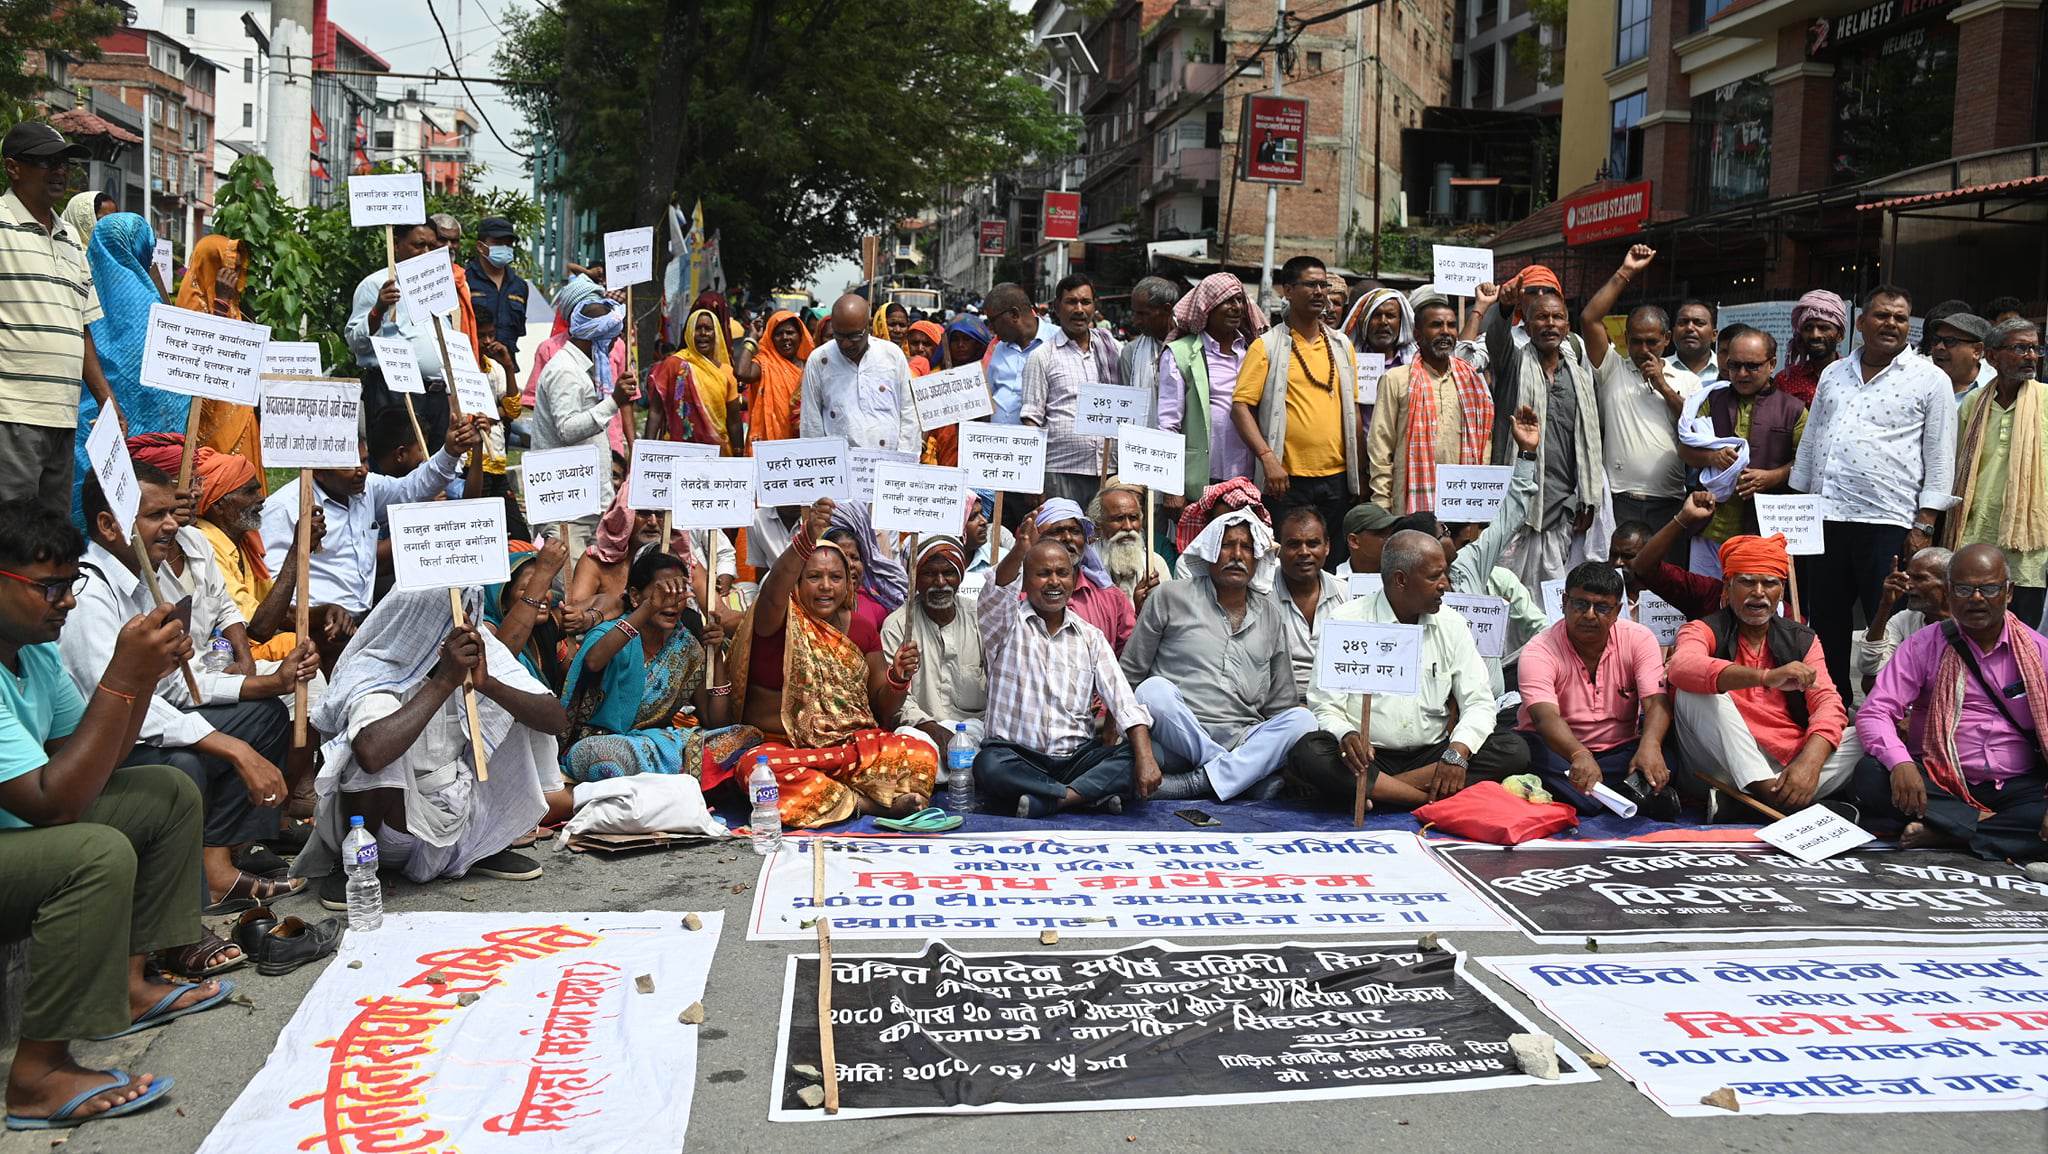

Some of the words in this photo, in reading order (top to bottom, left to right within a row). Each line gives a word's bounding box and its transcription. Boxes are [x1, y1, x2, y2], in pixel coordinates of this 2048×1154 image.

[1837, 1, 1894, 39] HELMETS
[1576, 200, 1608, 225] CHICKEN
[1609, 192, 1643, 219] STATION
[184, 326, 216, 340] प्रशासन
[216, 335, 261, 349] कार्यालयमा
[167, 367, 201, 381] अधिकार
[1093, 397, 1112, 409] २४९
[1086, 413, 1113, 424] खारेज
[967, 433, 1008, 446] अदालतमा
[1012, 436, 1039, 447] कपाली
[766, 457, 791, 472] प्रहरी
[796, 456, 837, 469] प्रशासन
[972, 451, 1014, 463] तमसुकको
[528, 472, 553, 487] २०८०
[556, 465, 595, 481] अध्यादेश
[643, 469, 673, 481] तमसुक
[982, 468, 999, 479] दर्ता
[1002, 470, 1015, 481] गर
[763, 479, 788, 492] दवन
[819, 476, 835, 488] गर
[884, 479, 907, 490] कानुन
[938, 483, 958, 494] गरेको
[1446, 479, 1468, 490] प्रहरी
[1470, 481, 1504, 491] प्रशासन
[538, 490, 564, 505] खारेज
[567, 488, 581, 500] गर
[691, 499, 713, 510] सहज
[717, 499, 730, 510] गर
[882, 492, 904, 503] लगानी
[906, 494, 929, 505] कानुन
[1487, 499, 1501, 508] गर
[402, 525, 431, 537] कानुन
[434, 519, 467, 533] बमोजिम
[470, 517, 495, 529] गरेको
[403, 540, 431, 552] लगानी
[435, 538, 461, 551] कानुन
[419, 556, 442, 568] फिर्ता
[445, 553, 479, 566] गरियोस्
[1472, 604, 1502, 615] कपाली
[1646, 600, 1669, 609] अदाल
[1342, 639, 1367, 655] २४९
[1334, 661, 1370, 677] खारेज
[1376, 664, 1395, 678] गर
[950, 838, 1109, 856] लेनदेन
[1127, 840, 1237, 856] संघर्ष
[1253, 838, 1399, 856] समिति
[1600, 850, 1750, 874] लेनदेन
[852, 870, 1057, 891] विरोध
[1078, 871, 1376, 891] कार्यक्रम
[791, 894, 916, 909] २०८०
[1113, 891, 1307, 906] अध्यादेश
[1320, 891, 1452, 907] कानुन
[1589, 882, 1795, 907] विरोध
[1794, 886, 2007, 912] जुलुस
[831, 913, 1001, 930] खारिज
[1133, 912, 1300, 929] खारिज
[1314, 911, 1386, 926] गर
[1529, 962, 1701, 987] पिडित
[1703, 959, 1902, 983] लेनदेन
[1898, 957, 2044, 980] संघर्ष
[1746, 989, 1858, 1007] मधेश
[1858, 987, 1963, 1006] प्रदेश
[962, 1000, 992, 1022] २०
[998, 1002, 1038, 1023] गते
[1663, 1010, 1914, 1039] विरोध
[1291, 1027, 1428, 1044] आयोजक
[1278, 1047, 1344, 1067] लेनदेन
[1397, 1043, 1457, 1060] समिति
[1639, 1047, 1791, 1067] २०८०
[1796, 1037, 1999, 1062] सालको
[1273, 1068, 1310, 1084] मो
[1726, 1074, 1936, 1098] खारिज
